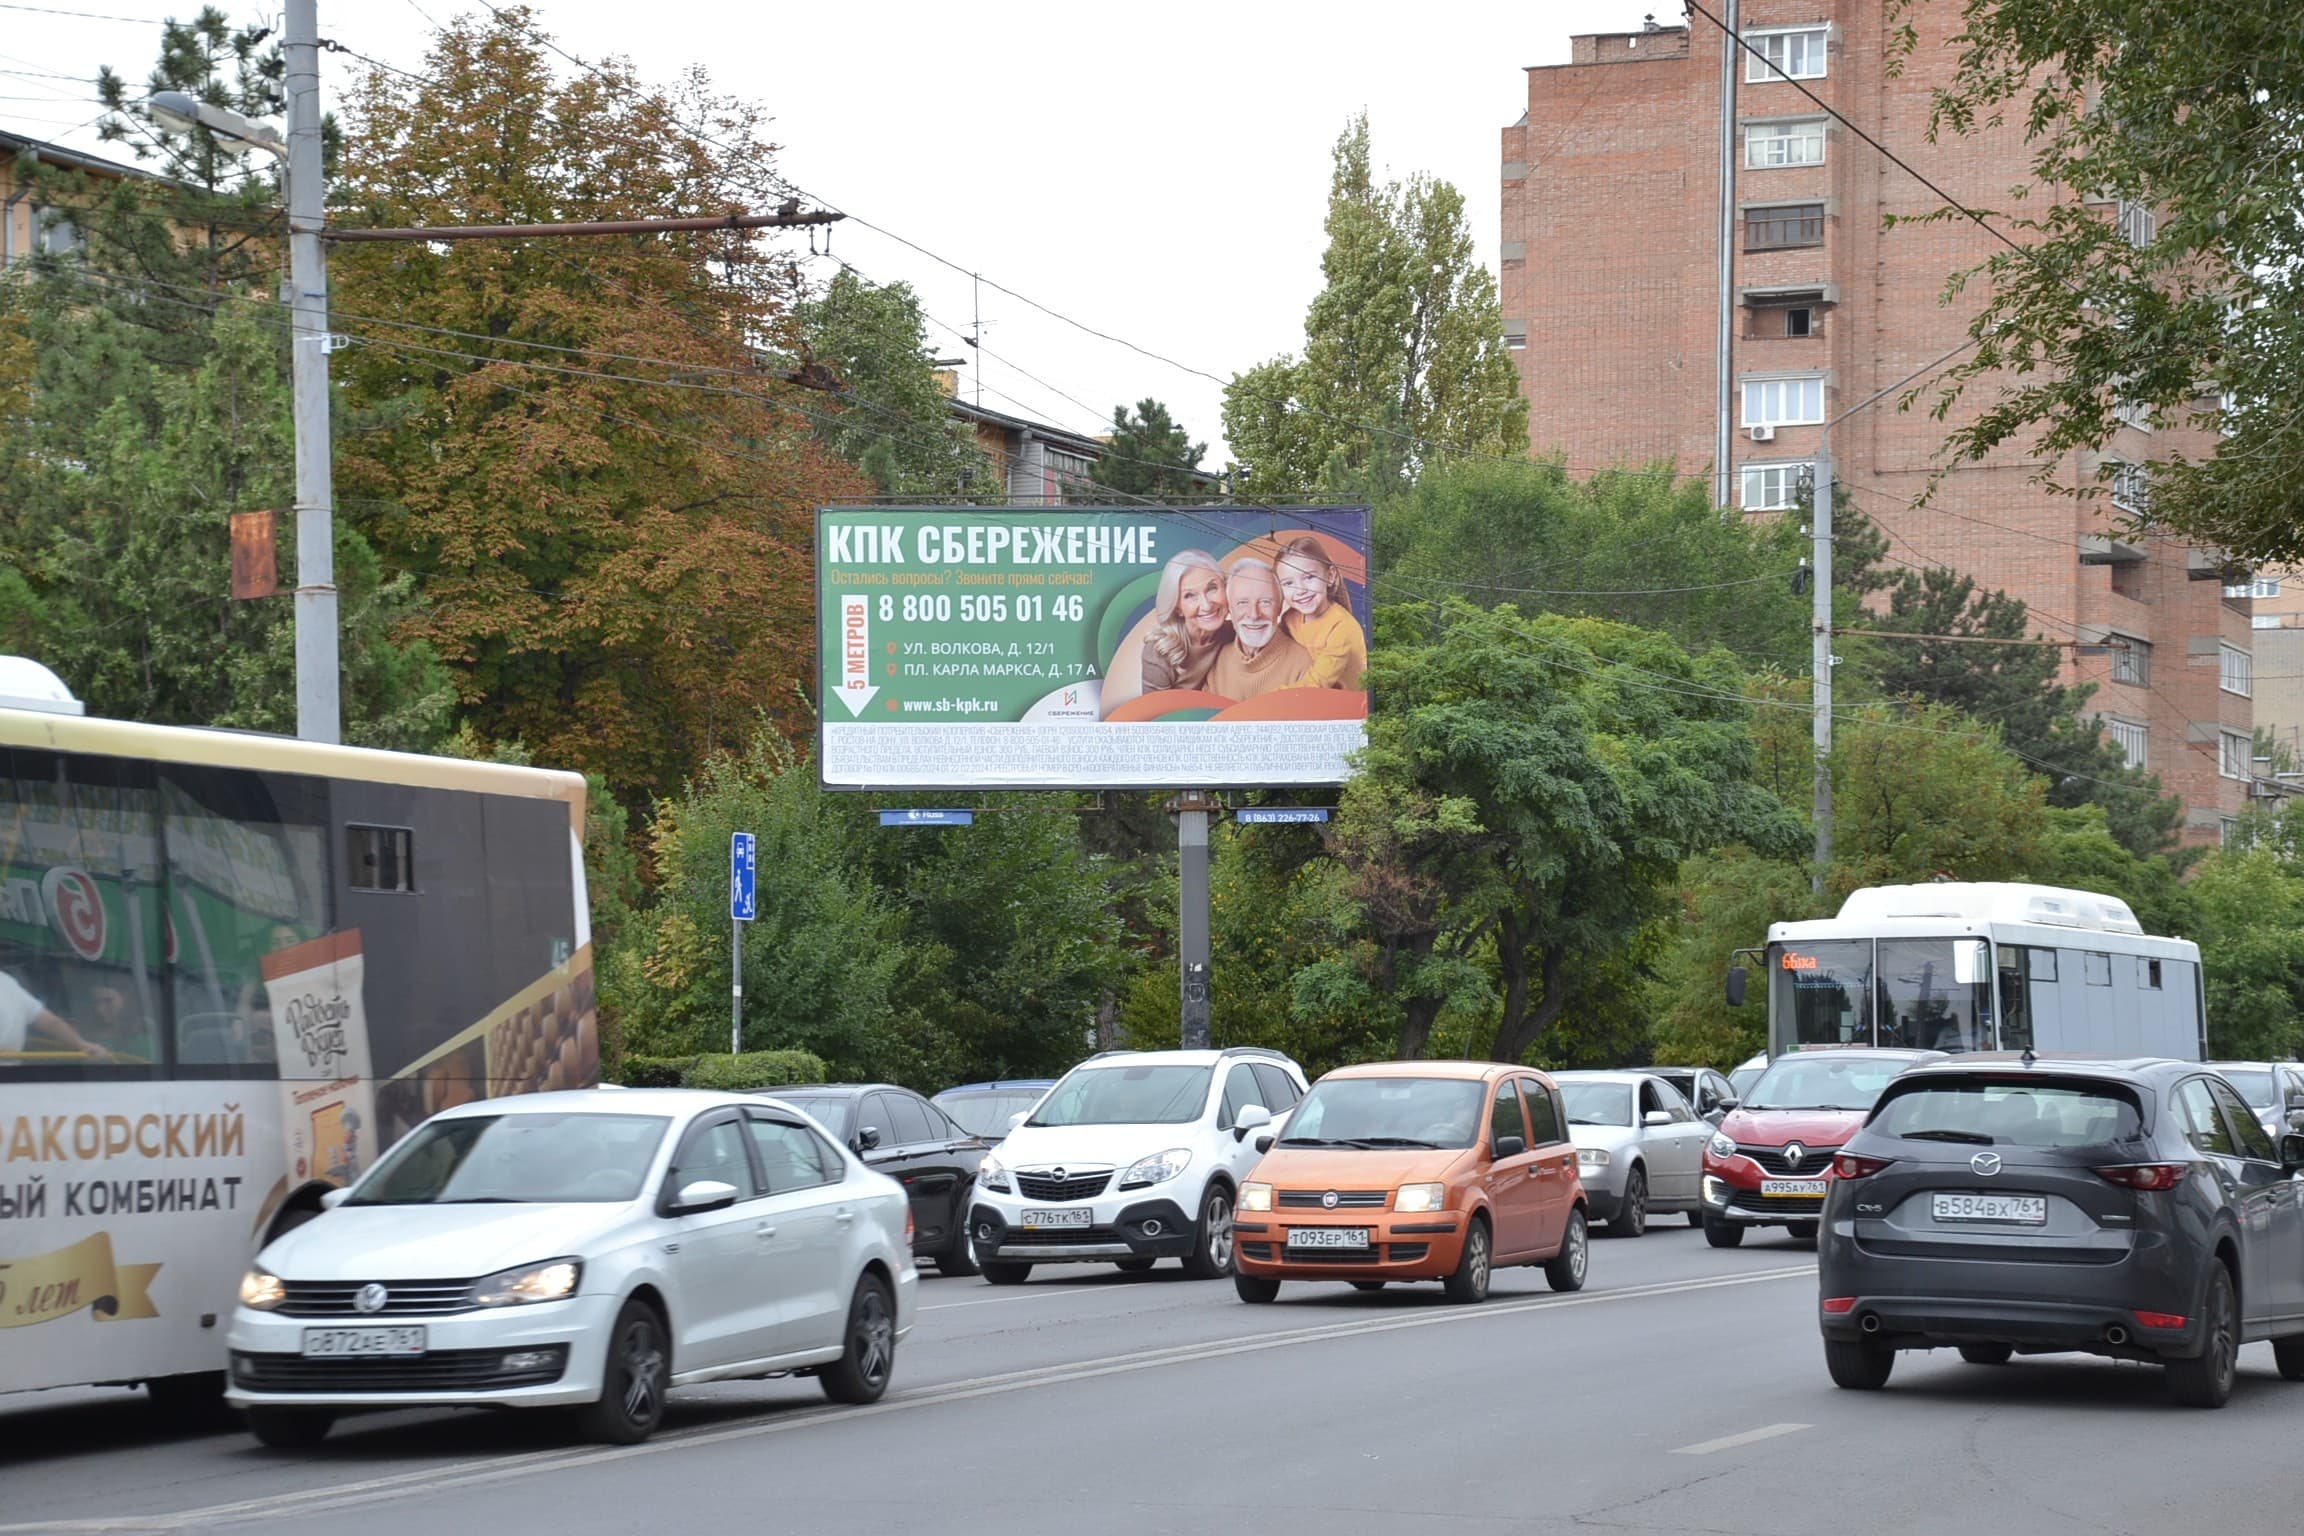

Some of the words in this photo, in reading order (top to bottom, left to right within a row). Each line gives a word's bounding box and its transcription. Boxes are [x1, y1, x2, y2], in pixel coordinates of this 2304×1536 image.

[828, 525, 904, 563] КПК
[917, 526, 1157, 564] СБЕРЕЖЕНИЕ
[831, 568, 888, 585] Остались
[892, 569, 952, 587] вопросы?
[956, 569, 1004, 585] Звоните
[1008, 573, 1045, 588] прямо
[1048, 570, 1093, 585] сейчас!
[879, 594, 894, 621] 8
[903, 594, 951, 621] 800
[960, 594, 1007, 621] 505
[1016, 594, 1042, 621] 01
[1051, 594, 1084, 621] 46
[847, 604, 865, 673] МЕТРОВ
[903, 642, 927, 655] УЛ.
[931, 642, 1004, 656] ВОЛКОВА,
[1007, 642, 1022, 657] Д.
[1026, 642, 1054, 655] 12/1
[904, 663, 929, 676] ПЛ.
[933, 663, 979, 676] КАРЛА
[983, 663, 1045, 678] МАРКСА,
[1048, 663, 1063, 678] Д.
[1067, 663, 1083, 676] 17
[1086, 663, 1096, 676] А
[847, 680, 865, 690] 5
[903, 697, 998, 715] www.sb-kpk.ru
[1245, 814, 1251, 822] 8
[1253, 813, 1275, 822] (863)
[1277, 813, 1320, 822] 226-77-26
[0, 1103, 245, 1163] АКОРСКИЙ
[64, 1176, 243, 1217] КОМБИНАТ
